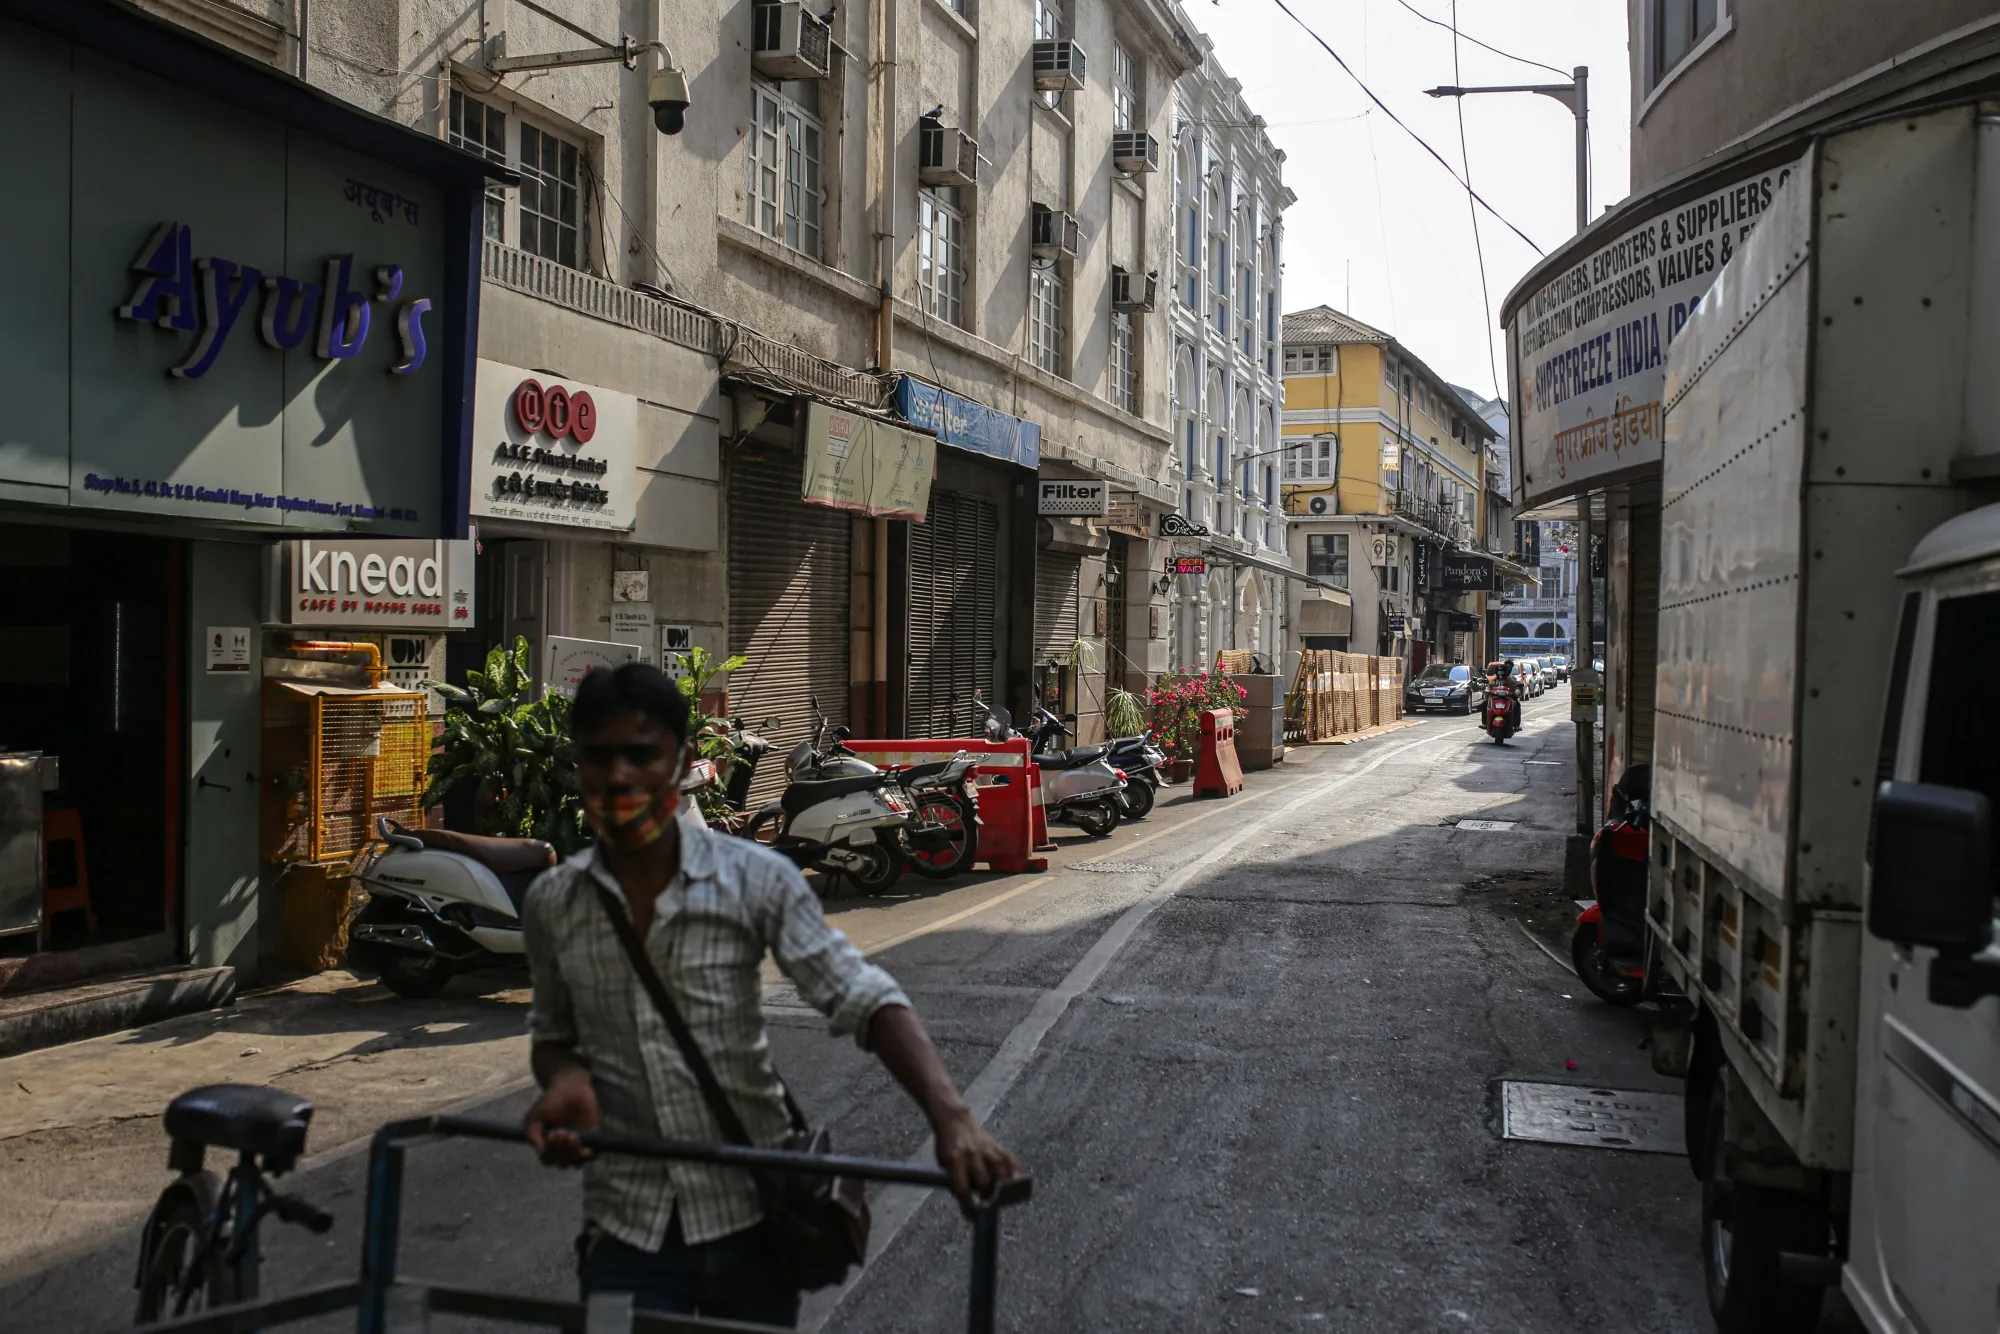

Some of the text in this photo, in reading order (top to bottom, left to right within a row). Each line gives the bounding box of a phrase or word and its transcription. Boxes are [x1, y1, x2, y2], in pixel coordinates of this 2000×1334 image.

[1526, 263, 1592, 326] MANUFACTURERS,
[1593, 226, 1656, 285] EXPORTERS
[1660, 219, 1672, 251] &
[1676, 177, 1772, 245] SUPPLIERS
[117, 221, 432, 379] Ayub's
[1522, 305, 1573, 359] REFRIGERATION
[1574, 268, 1656, 329] COMPRESSORS,
[1657, 239, 1715, 289] VALVES
[1720, 232, 1733, 266] &
[1535, 331, 1612, 414] SUPERFREEZE
[1617, 312, 1662, 384] INDIA
[829, 417, 849, 435] USHA
[1042, 484, 1101, 499] Filter
[302, 540, 443, 596] knead
[1180, 558, 1203, 566] GOPI
[1180, 565, 1202, 573] VAID
[1444, 563, 1488, 577] Pandora's
[341, 600, 359, 612] BY
[386, 671, 428, 679] URBAN
